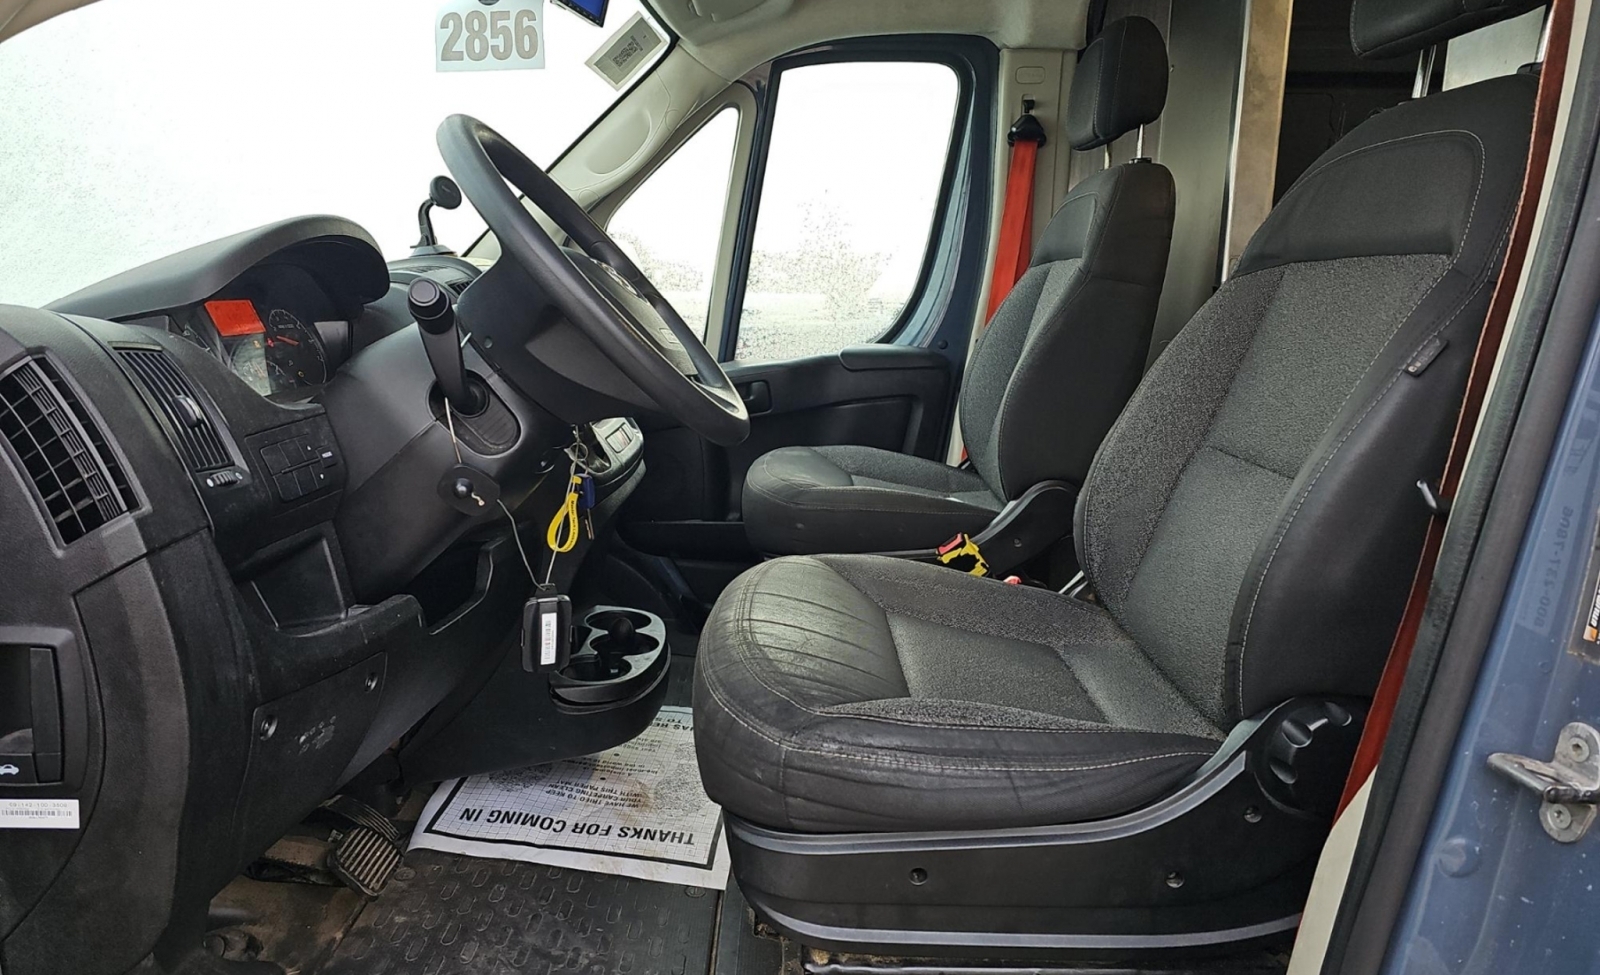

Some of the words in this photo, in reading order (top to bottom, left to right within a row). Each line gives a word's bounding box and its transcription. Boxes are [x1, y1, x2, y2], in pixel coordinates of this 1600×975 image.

[440, 9, 538, 61] 2856
[545, 789, 566, 797] KEEP
[548, 783, 574, 792] CLEAN
[573, 782, 599, 791] PAPER
[575, 788, 619, 801] CARPETING
[579, 796, 602, 805] TRIED
[459, 806, 483, 822] IN
[487, 809, 567, 833] COMING
[571, 821, 612, 837] FOR
[618, 825, 695, 846] THANKS
